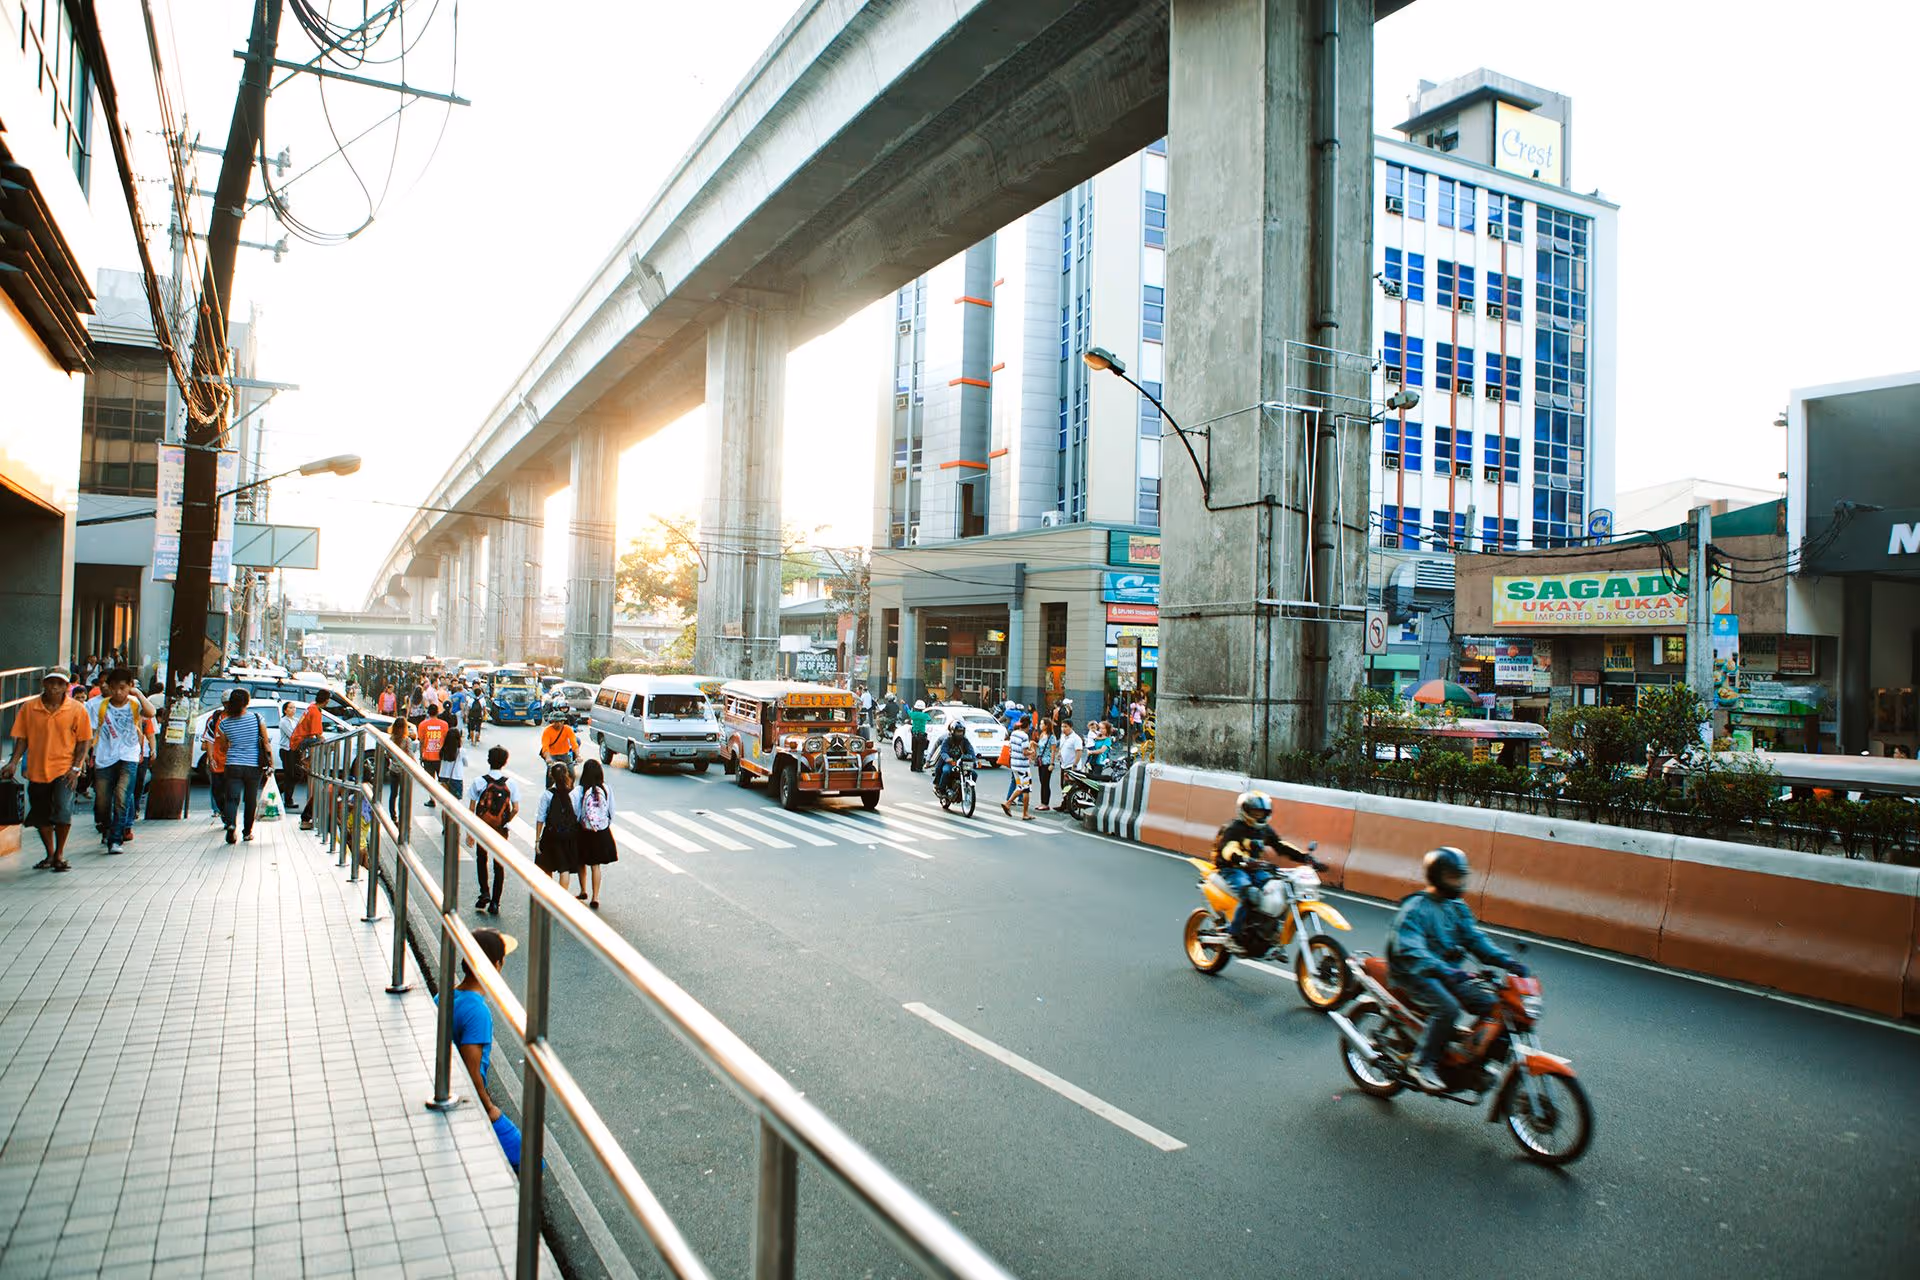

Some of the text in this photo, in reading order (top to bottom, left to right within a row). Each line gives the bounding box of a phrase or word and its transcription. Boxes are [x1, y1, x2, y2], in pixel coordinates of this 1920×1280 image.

[1502, 128, 1553, 168] Crest
[1888, 522, 1920, 555] M
[1522, 600, 1586, 612] UKAY
[1615, 596, 1688, 610] UKAY
[1535, 609, 1676, 621] IMPORTED DRY GOODS
[817, 662, 837, 672] PEACE
